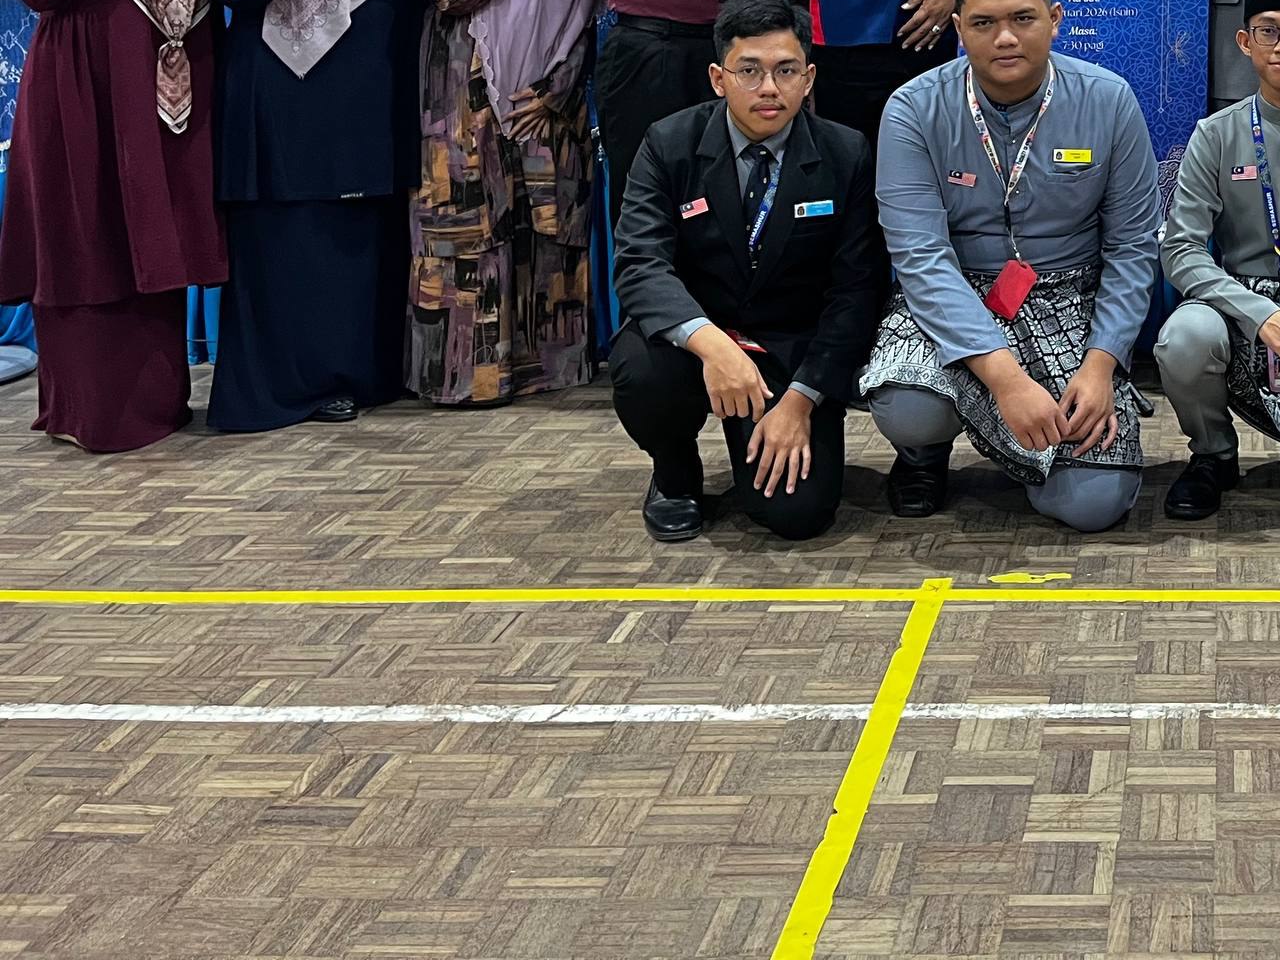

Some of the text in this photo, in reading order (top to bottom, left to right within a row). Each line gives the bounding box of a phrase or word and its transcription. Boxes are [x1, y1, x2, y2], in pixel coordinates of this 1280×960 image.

[1084, 6, 1108, 17] 2026
[1109, 6, 1139, 18] (Isnin)
[1068, 26, 1098, 36] Masa:
[1083, 40, 1105, 53] pagi
